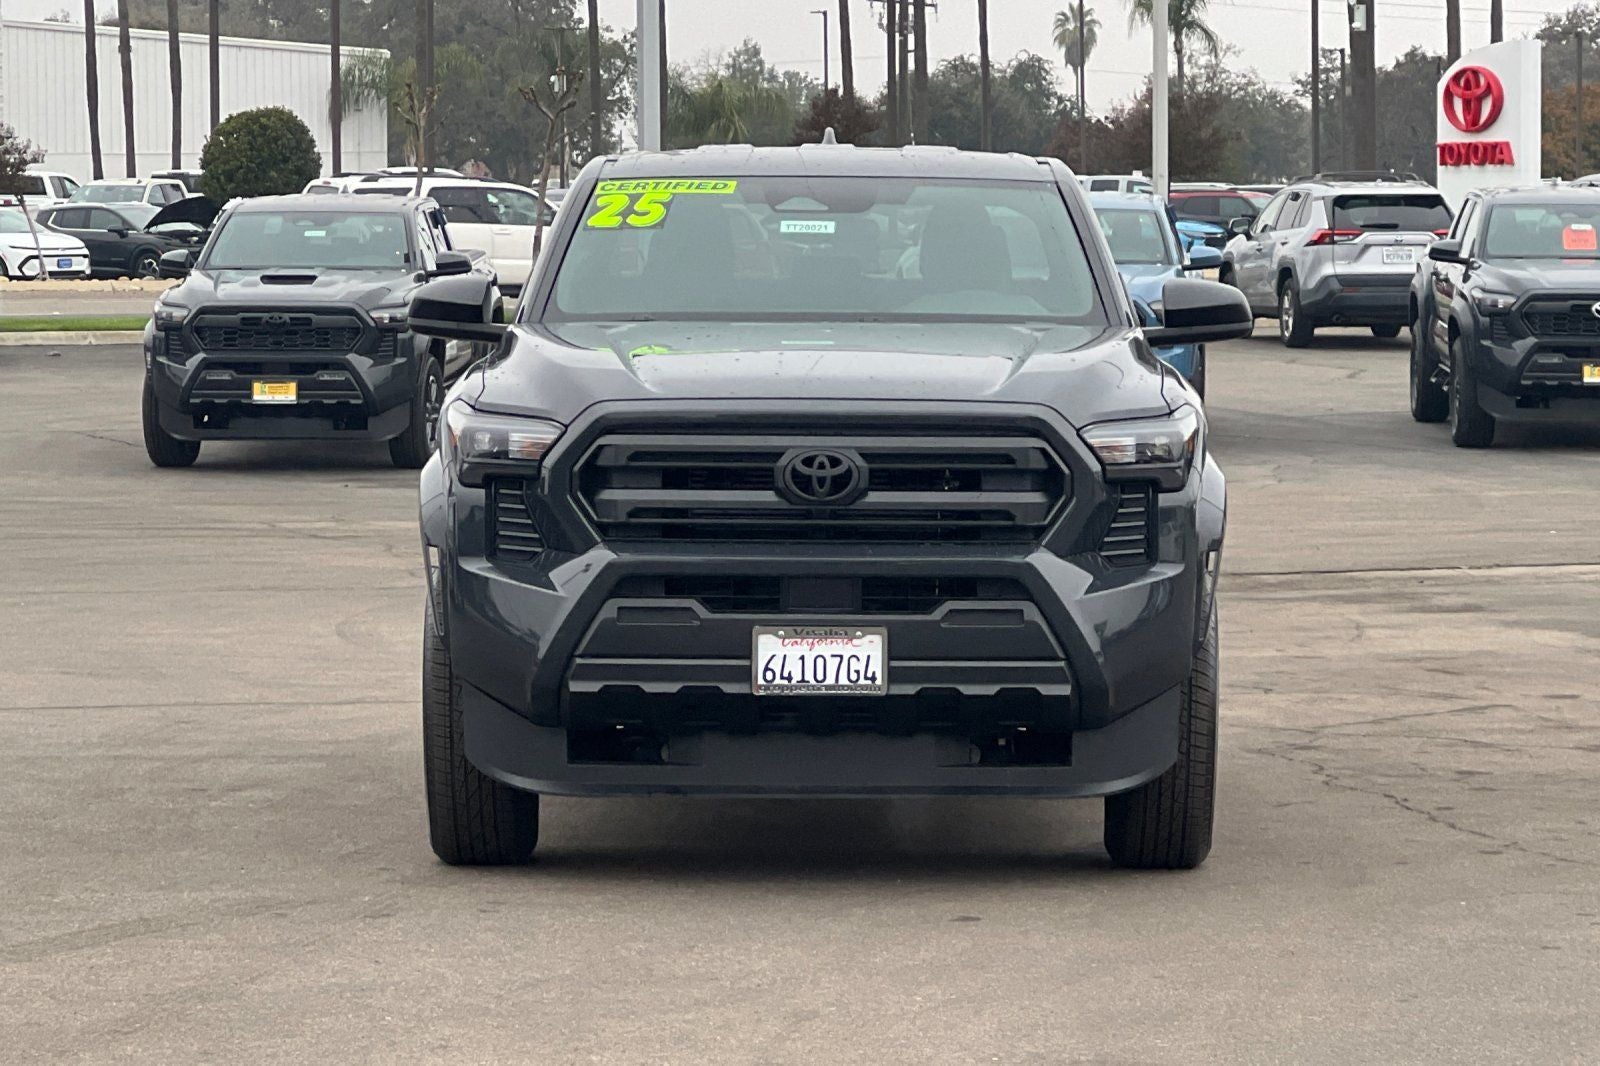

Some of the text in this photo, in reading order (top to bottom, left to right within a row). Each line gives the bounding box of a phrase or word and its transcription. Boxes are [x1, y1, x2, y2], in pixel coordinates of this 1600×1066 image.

[1437, 141, 1514, 166] TOYOTA
[600, 181, 729, 192] CERTIFIED
[587, 193, 672, 228] 25
[781, 637, 862, 651] California
[762, 654, 878, 684] 64107G4
